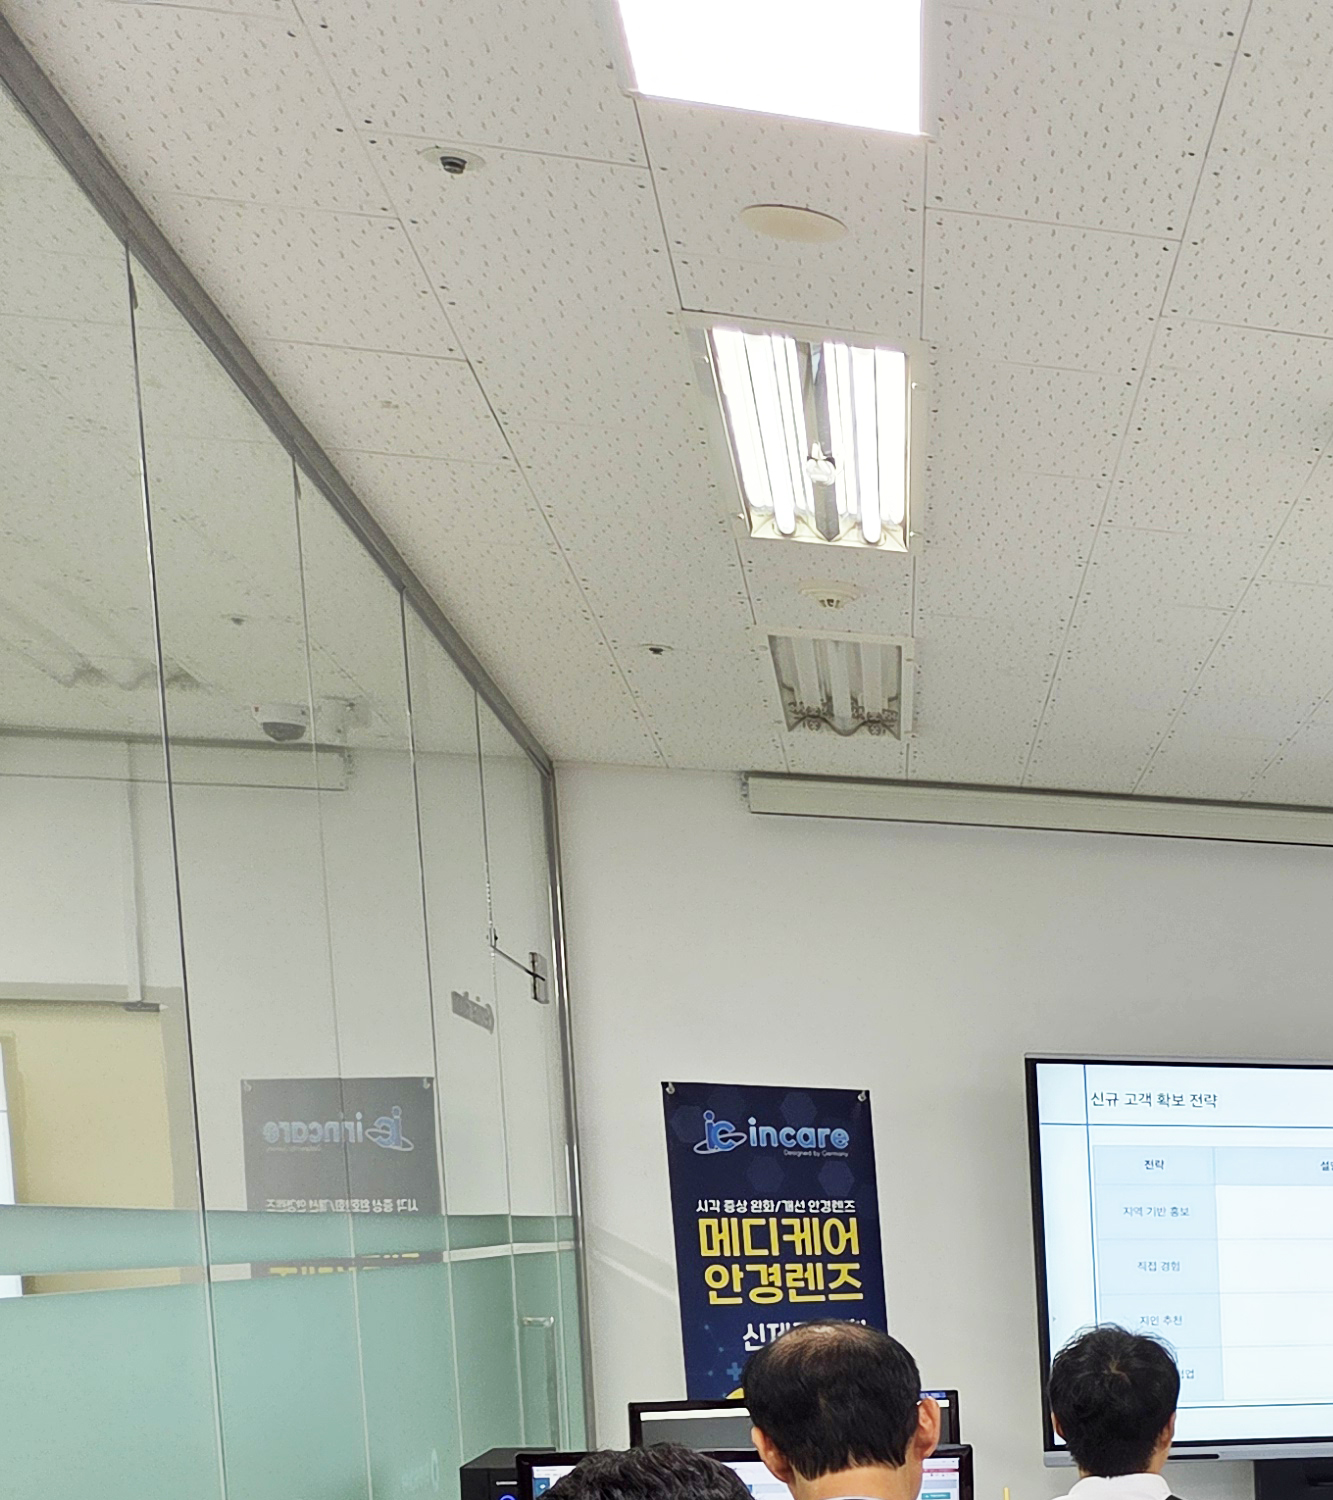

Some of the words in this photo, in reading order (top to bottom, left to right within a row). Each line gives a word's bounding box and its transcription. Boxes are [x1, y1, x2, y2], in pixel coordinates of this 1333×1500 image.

[1091, 1092, 1119, 1107] 신규
[1123, 1092, 1152, 1107] 고객
[1156, 1093, 1186, 1108] 확보
[1190, 1093, 1218, 1108] 전략
[748, 1116, 850, 1149] incare
[1144, 1159, 1165, 1171] 전략
[696, 1199, 721, 1213] 시각
[808, 1199, 857, 1214] 안경렌즈
[1123, 1206, 1143, 1218] 지역
[1146, 1206, 1167, 1218] 기반
[698, 1217, 860, 1257] 메디케어
[704, 1262, 864, 1305] 안경렌즈
[1140, 1315, 1160, 1326] 지인
[1163, 1315, 1183, 1326] 추천
